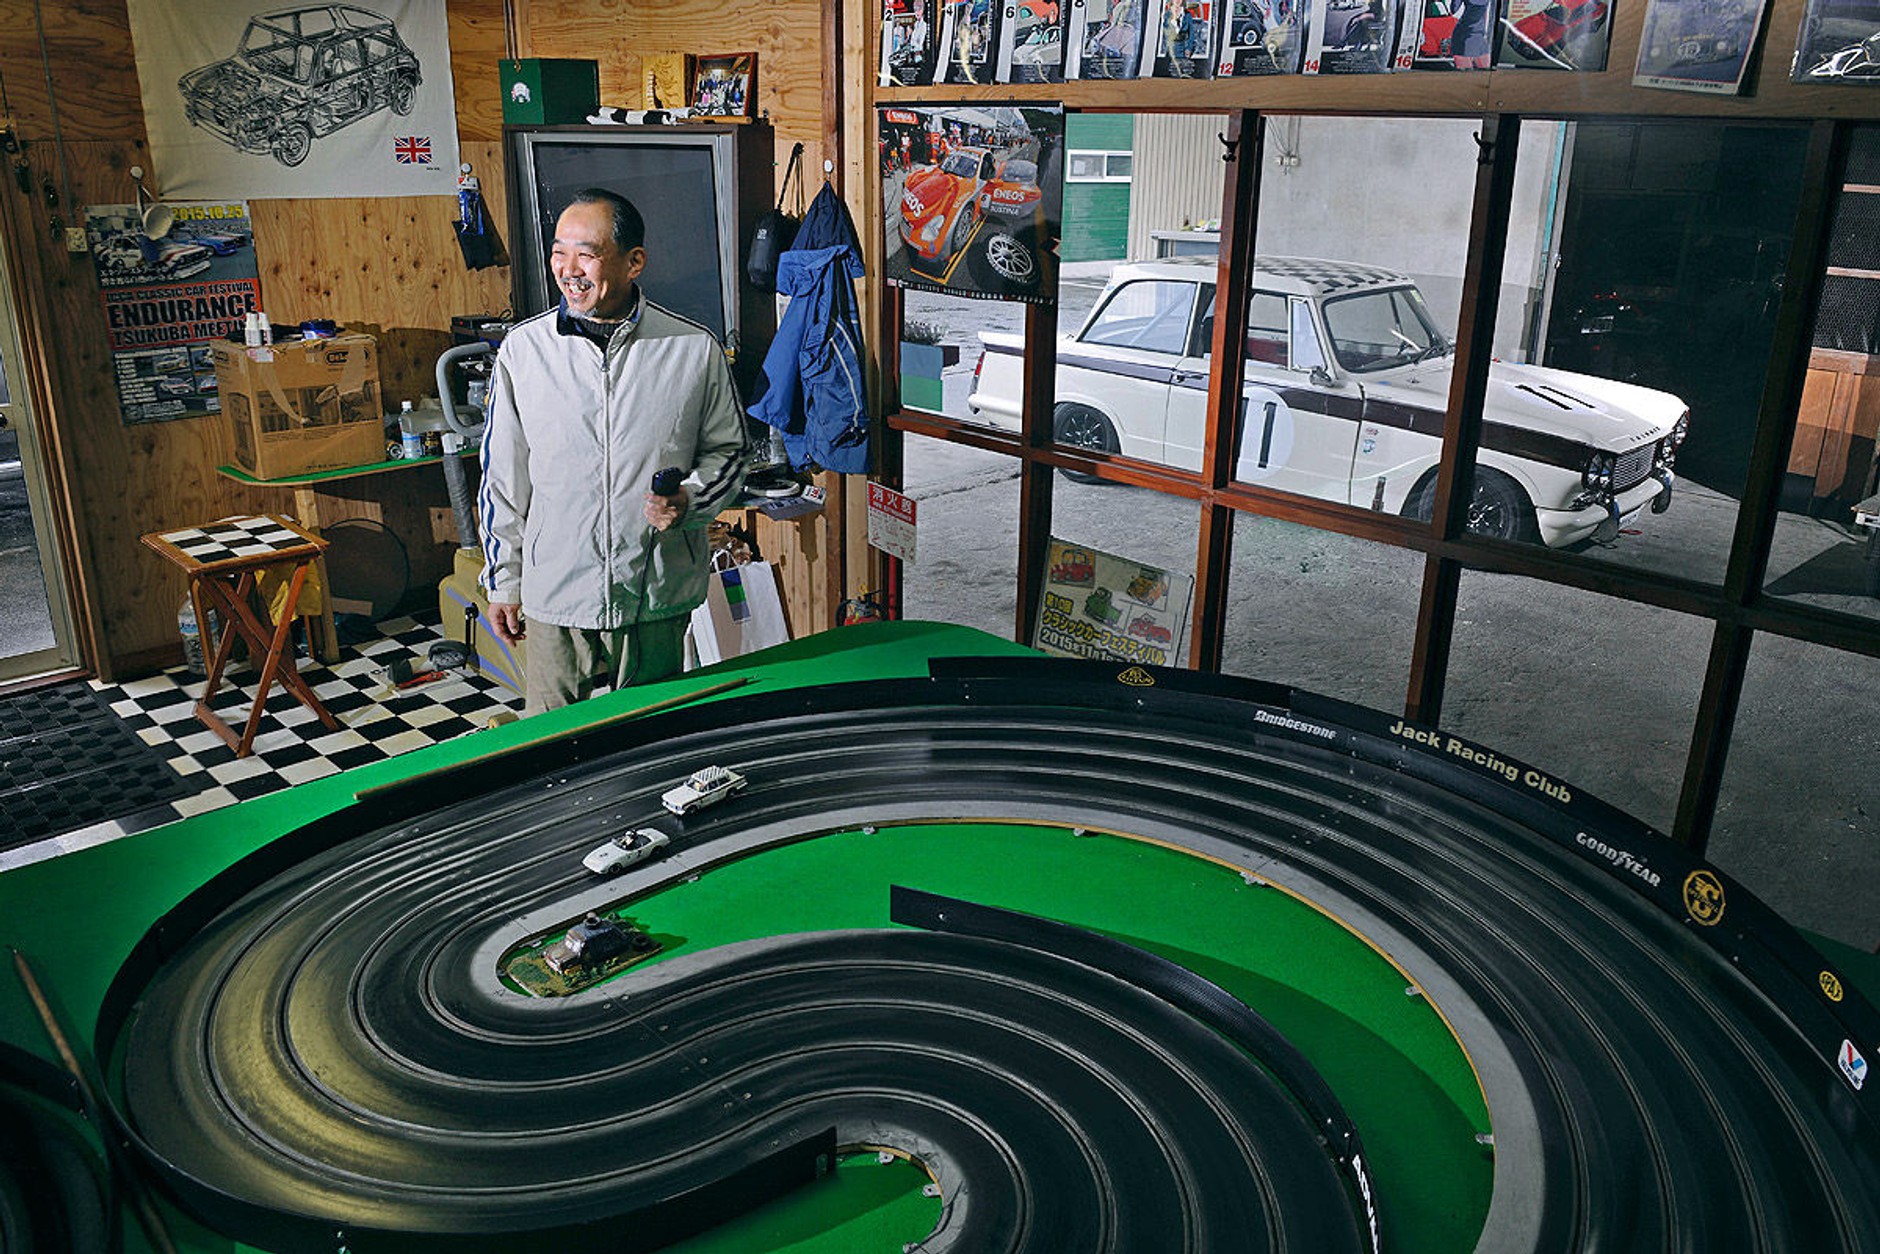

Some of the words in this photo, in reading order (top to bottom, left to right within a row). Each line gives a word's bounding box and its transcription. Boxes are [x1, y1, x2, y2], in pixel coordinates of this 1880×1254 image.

[885, 10, 894, 22] 2
[1006, 7, 1015, 19] 6
[1219, 62, 1234, 75] 12
[1305, 60, 1319, 72] 14
[1396, 55, 1412, 67] 16
[993, 188, 1025, 202] ENEOS
[137, 286, 183, 300] CLASSIC
[185, 283, 207, 297] CAR
[209, 281, 254, 295] FESTIVAL
[107, 294, 256, 328] ENDURANCE
[113, 325, 191, 346] TSUKUBA
[193, 319, 247, 338] MEETIN
[1253, 709, 1338, 740] BRIDGESTONE
[1389, 720, 1442, 749] Jack
[1446, 737, 1520, 782] Racing
[1524, 770, 1573, 804] Club
[1575, 831, 1662, 888] GOODYEAR
